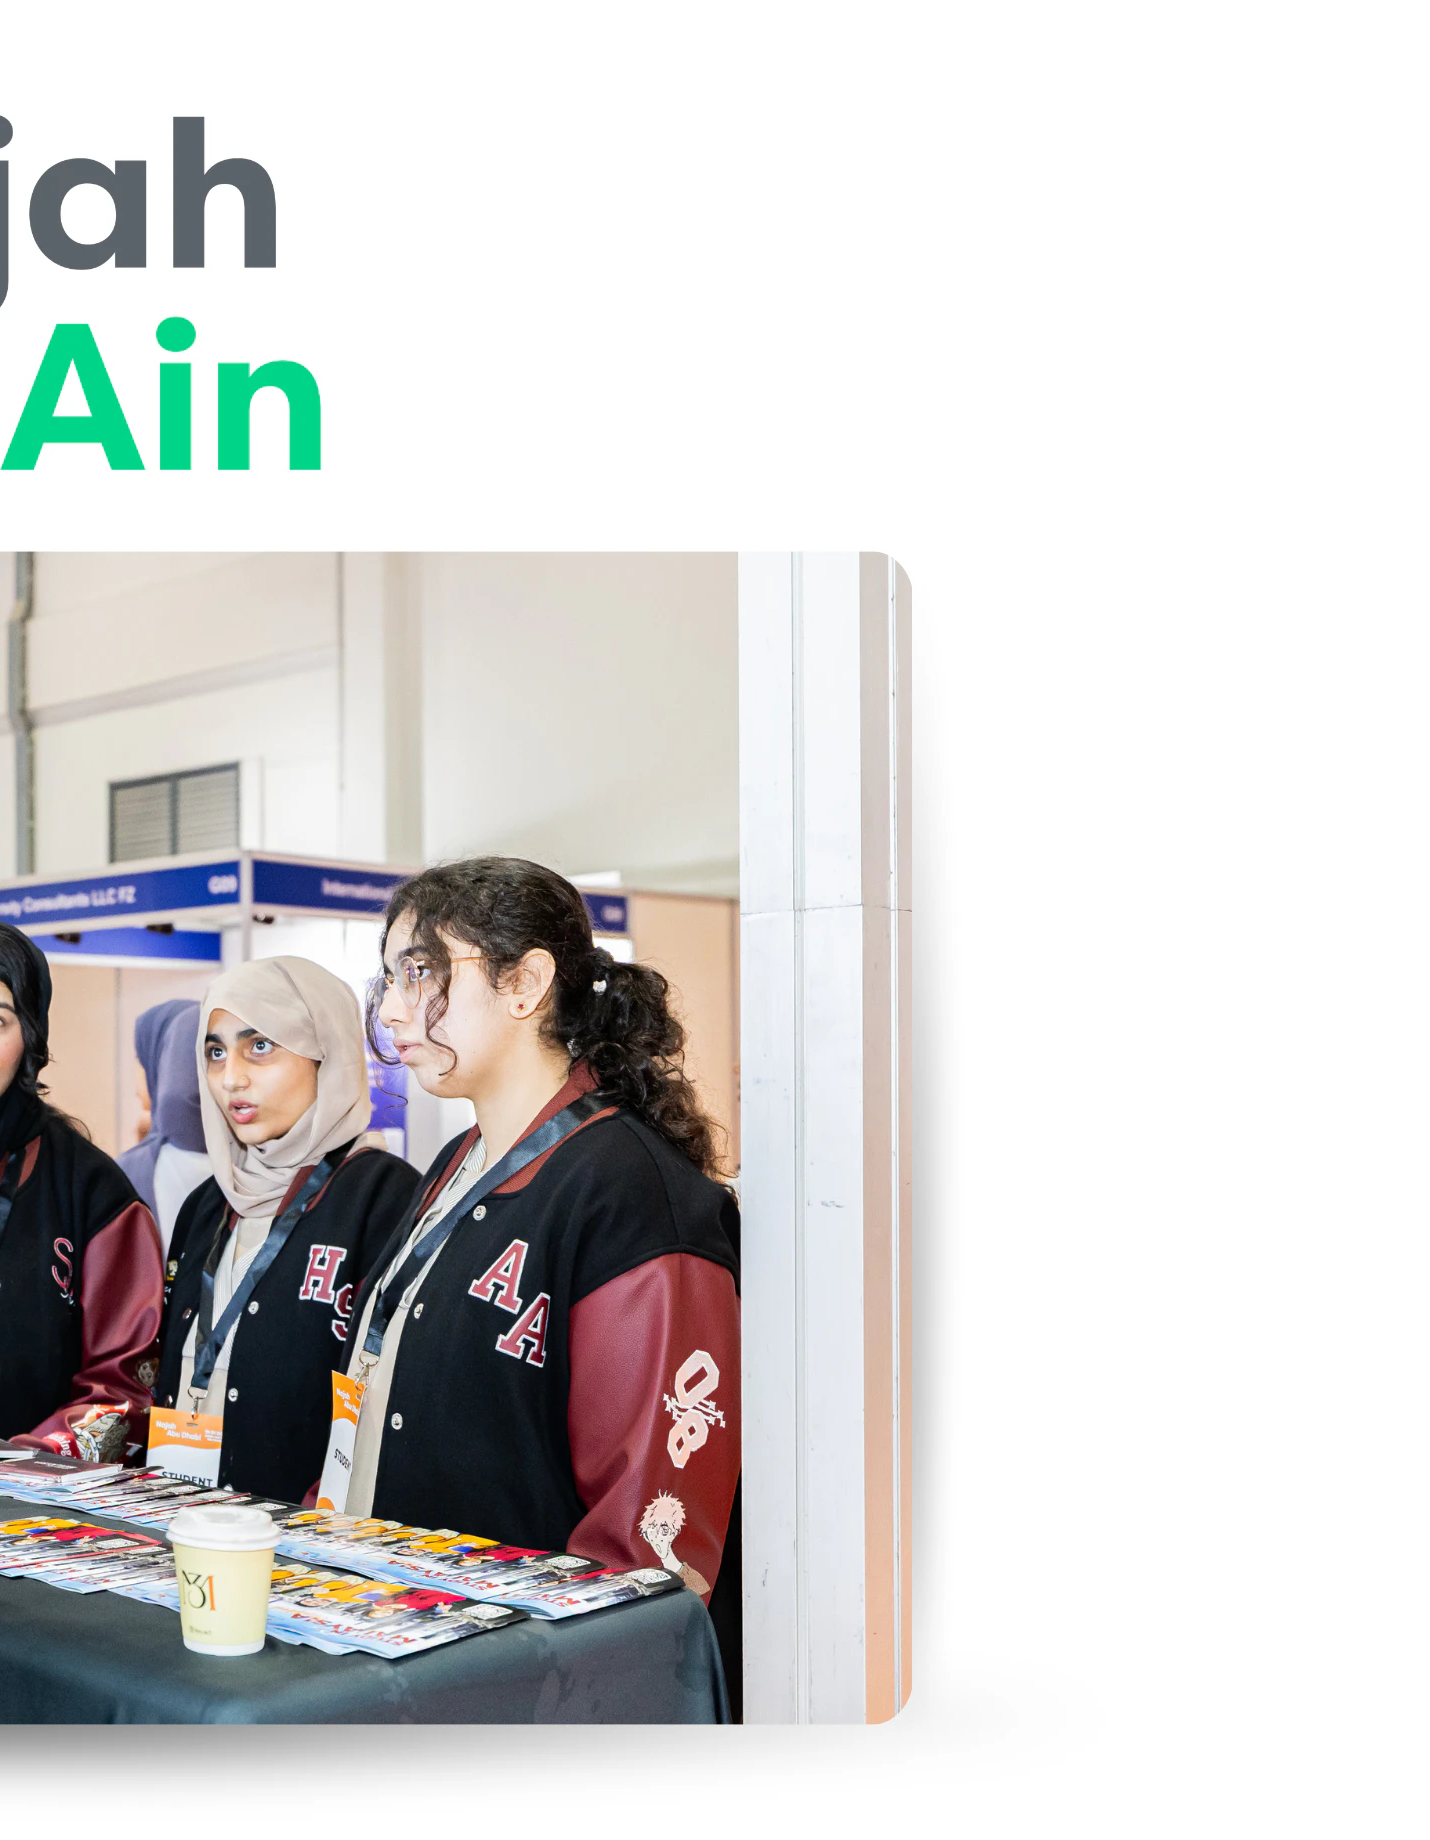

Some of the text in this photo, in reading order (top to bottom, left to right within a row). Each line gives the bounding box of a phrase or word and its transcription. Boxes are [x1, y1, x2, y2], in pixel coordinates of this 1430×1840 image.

[22, 892, 90, 914] Consultants
[91, 889, 117, 907] LLC
[118, 885, 137, 904] FZ
[299, 1243, 347, 1304] H
[468, 1238, 551, 1368] A A
[155, 1420, 176, 1431] Najah
[166, 1429, 181, 1438] Abu
[181, 1431, 202, 1441] Dhabi
